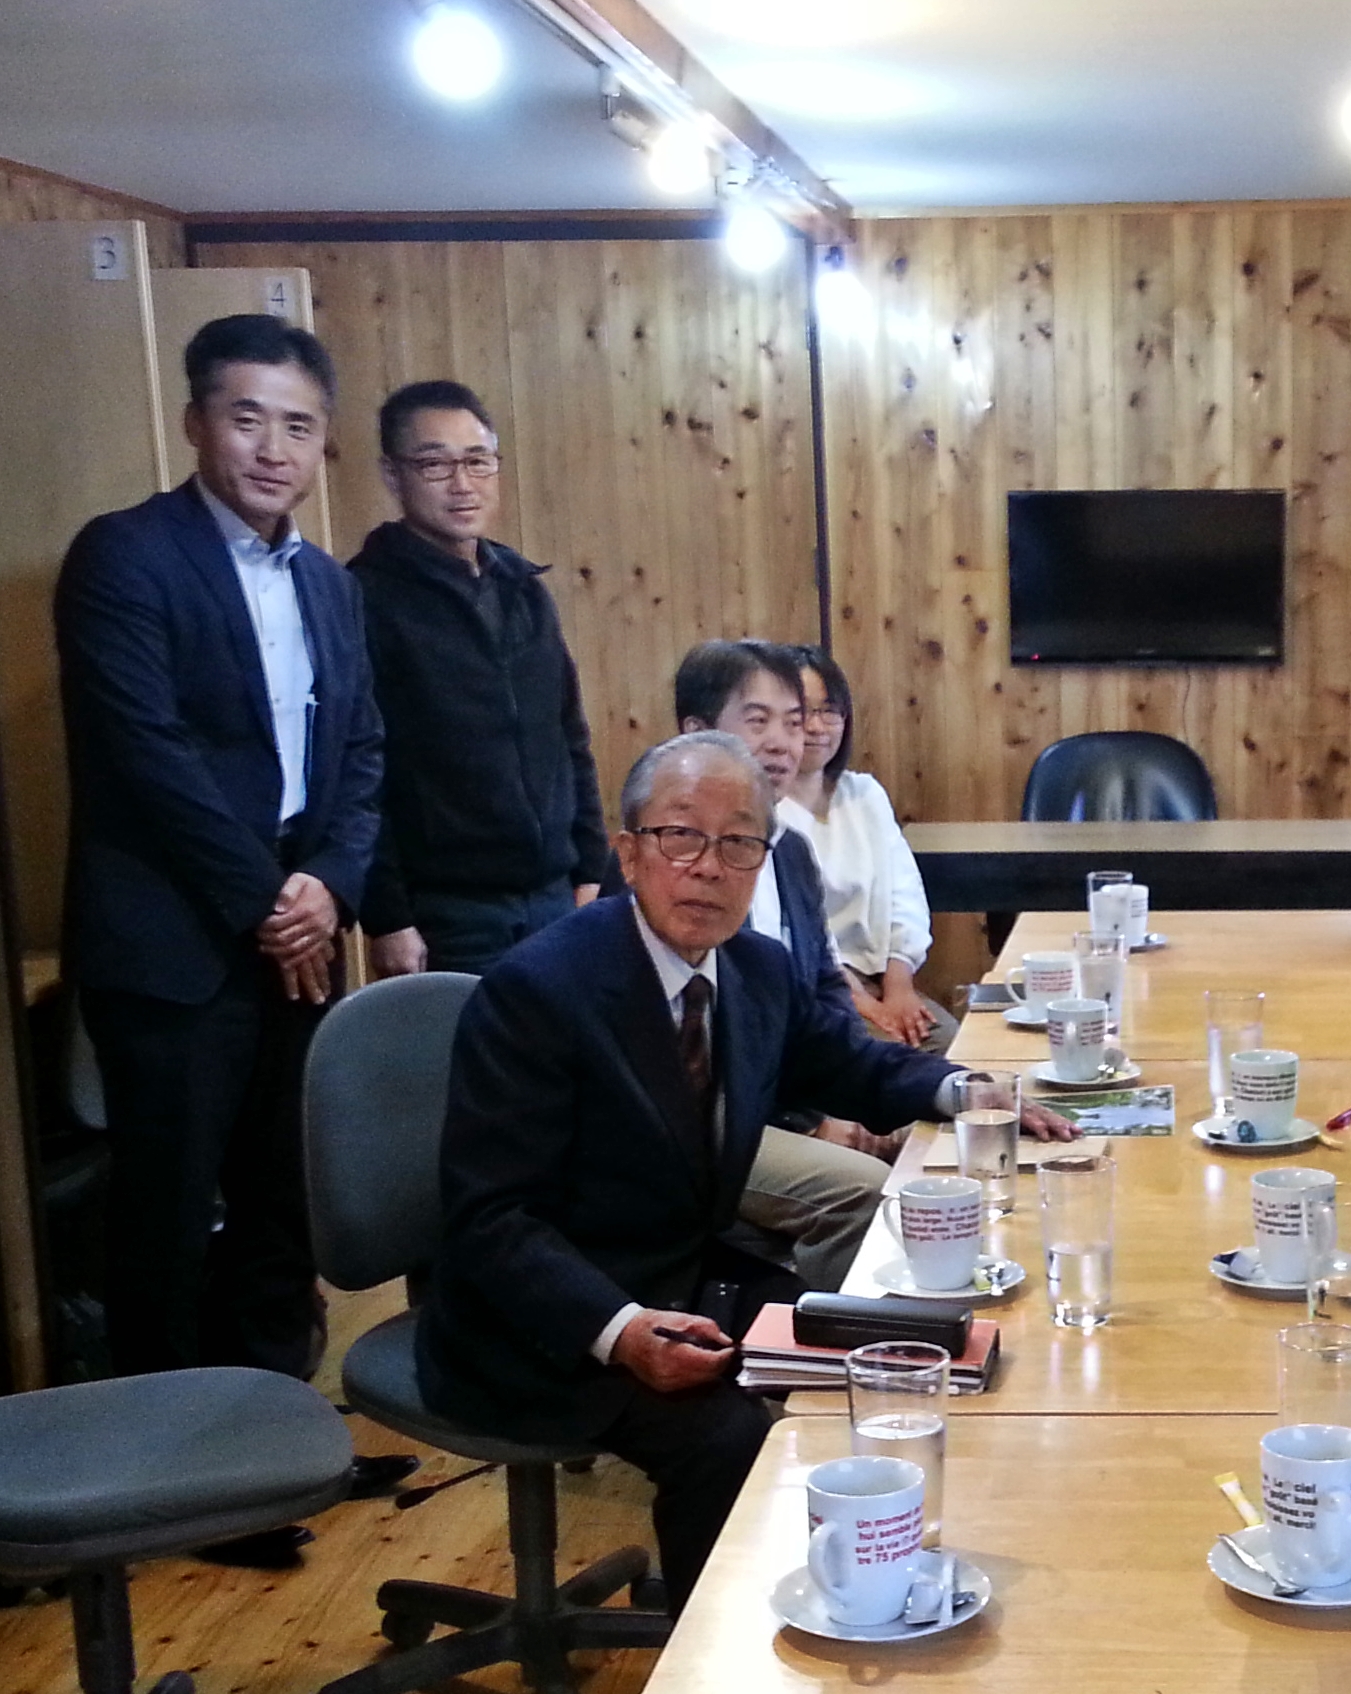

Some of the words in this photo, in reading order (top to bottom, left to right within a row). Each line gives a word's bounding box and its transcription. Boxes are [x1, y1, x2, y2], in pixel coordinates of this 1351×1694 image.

[97, 236, 117, 270] 3
[270, 281, 286, 308] 4
[1293, 1483, 1317, 1495] ciel
[856, 1519, 872, 1529] Un
[874, 1510, 912, 1527] moment
[858, 1531, 876, 1541] hui
[876, 1551, 889, 1563] 75
